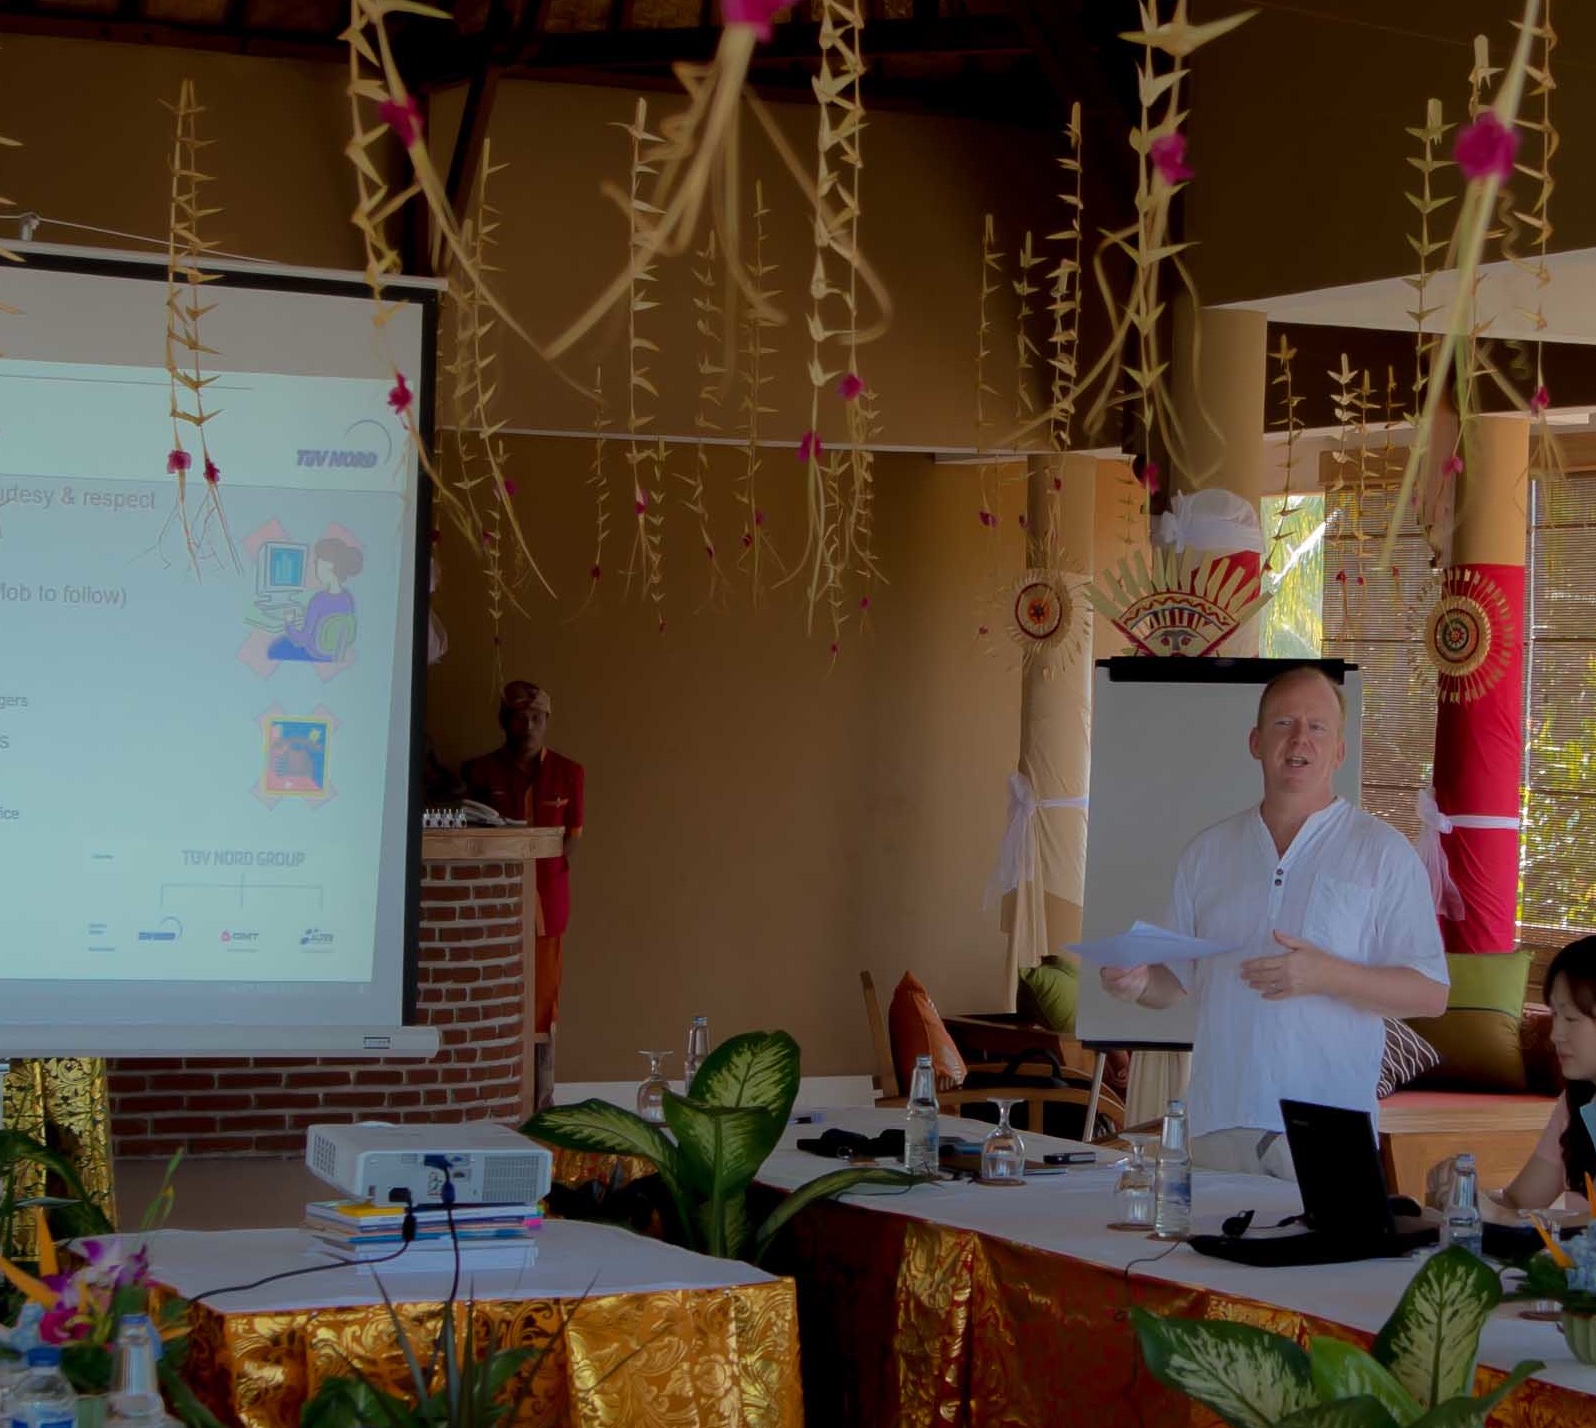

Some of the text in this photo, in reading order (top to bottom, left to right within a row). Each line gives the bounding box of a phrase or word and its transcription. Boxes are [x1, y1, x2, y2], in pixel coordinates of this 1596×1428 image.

[328, 451, 378, 468] NORD
[62, 486, 75, 505] &
[83, 491, 155, 511] respect
[38, 584, 57, 603] to
[63, 585, 127, 608] follow)
[214, 850, 253, 866] NORD
[256, 850, 306, 867] GROUP
